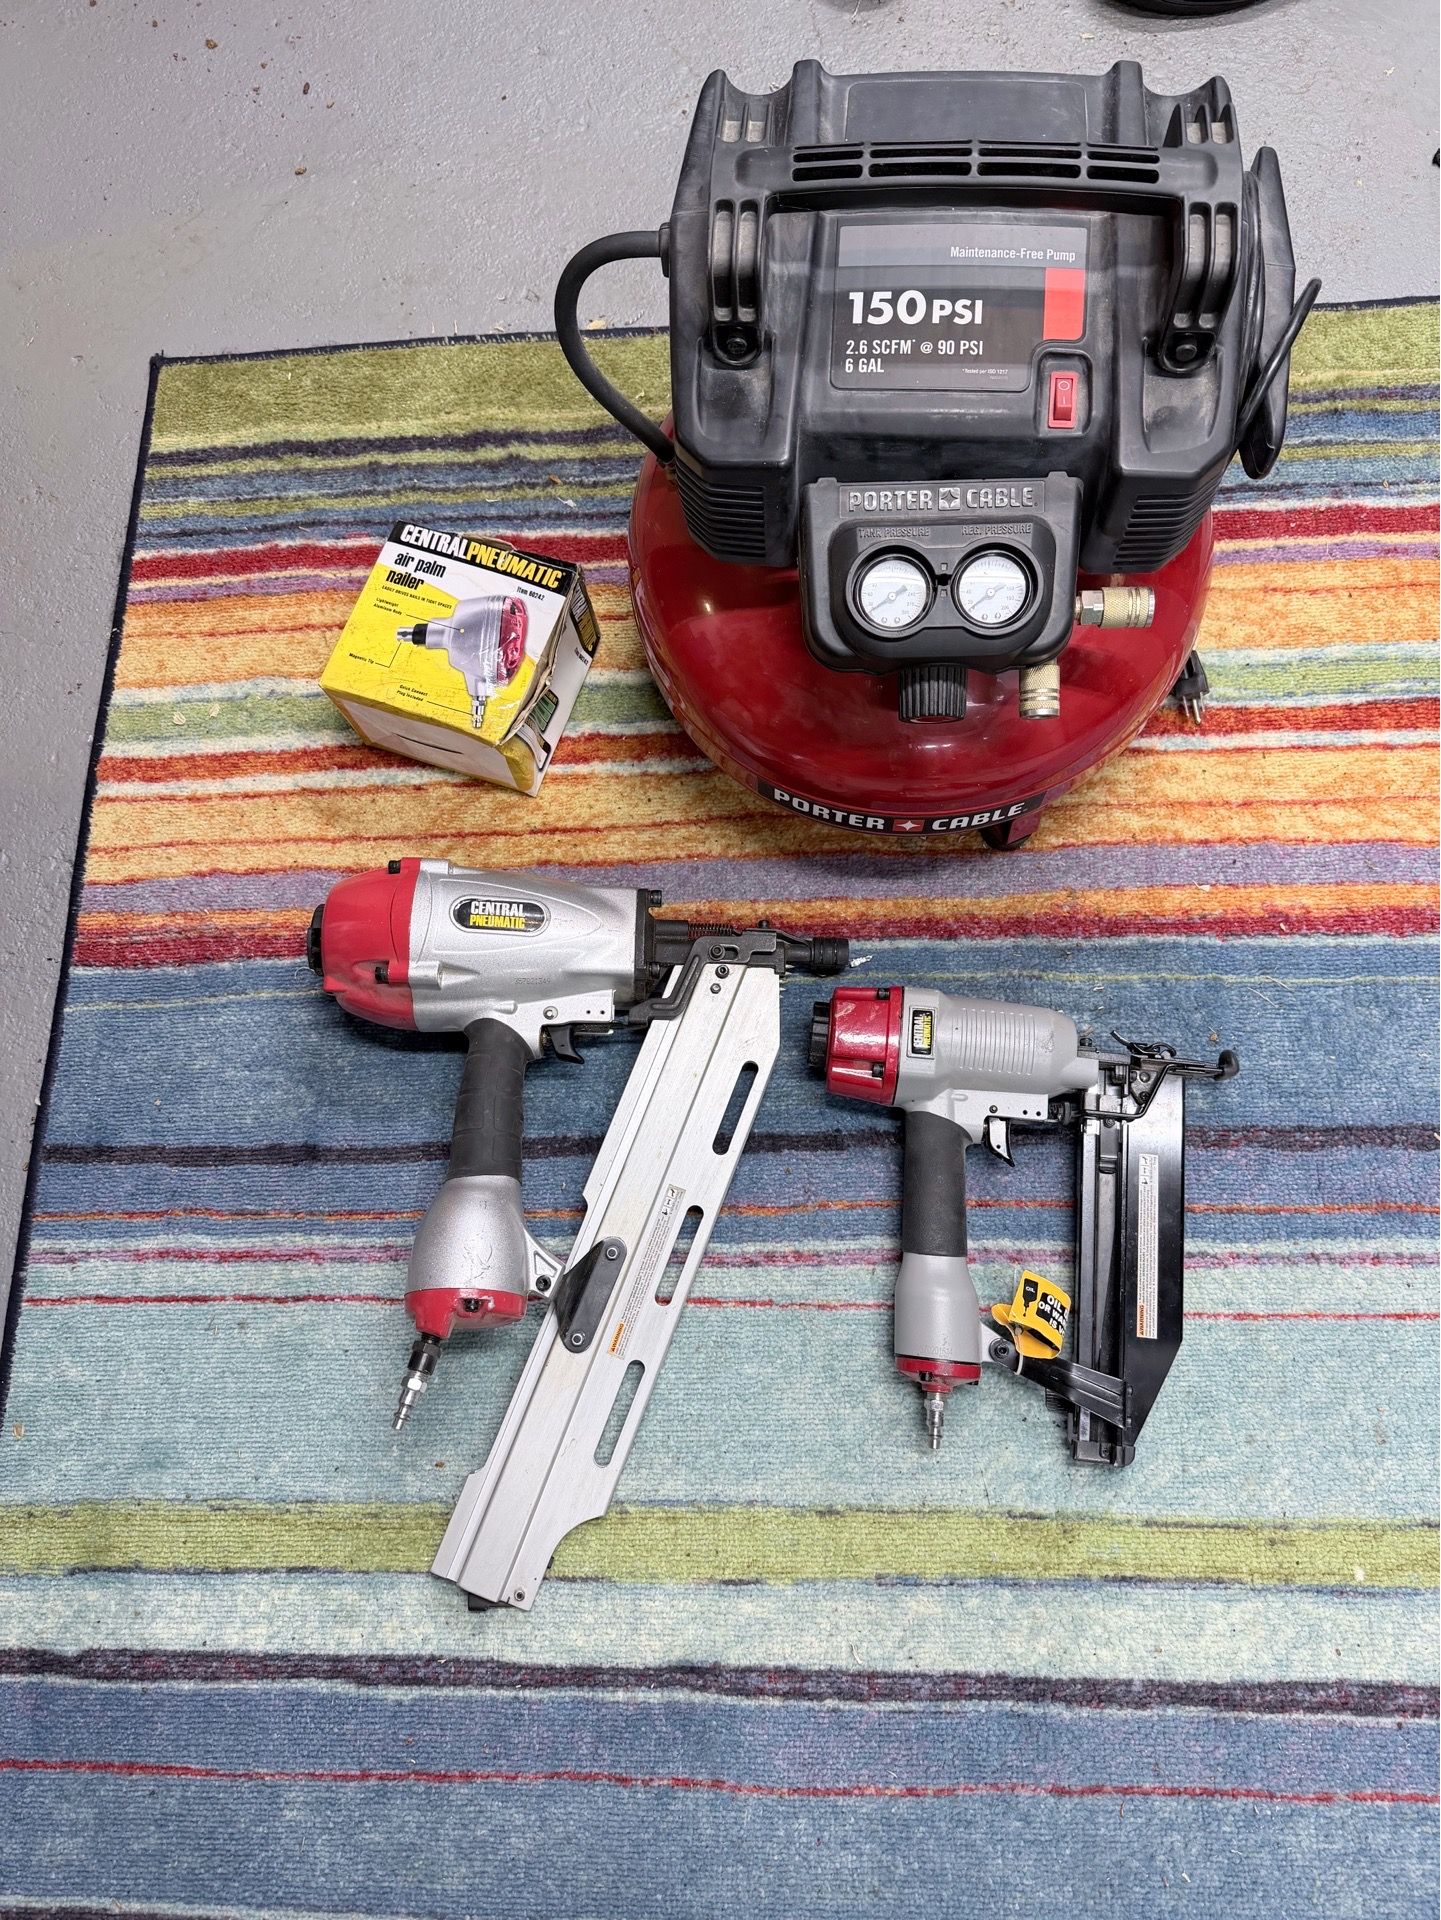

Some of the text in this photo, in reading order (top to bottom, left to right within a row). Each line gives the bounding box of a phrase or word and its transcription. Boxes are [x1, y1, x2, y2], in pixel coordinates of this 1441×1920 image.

[950, 246, 1076, 262] Maintenance-Free Pump
[849, 290, 983, 324] 150 PSI
[846, 340, 868, 354] 2.6
[920, 342, 933, 354] @
[938, 340, 955, 354] 90
[960, 341, 984, 355] PSI
[845, 358, 884, 374] 6 GAL
[849, 487, 1034, 511] PORTER CABLE
[858, 527, 930, 538] TANK PRESSURE
[962, 524, 1032, 536] REG. PRESSURE
[394, 552, 446, 578] air palm
[386, 570, 424, 590] nailer
[516, 586, 528, 596] Item
[774, 788, 1026, 831] PORTER CABLE
[470, 901, 525, 917] CENTRAL
[470, 914, 526, 930] PNEUMATIC
[1038, 1301, 1051, 1314] OR
[1046, 1294, 1062, 1314] OIL
[1049, 1318, 1058, 1329] IS
[612, 1323, 624, 1348] WARNING
